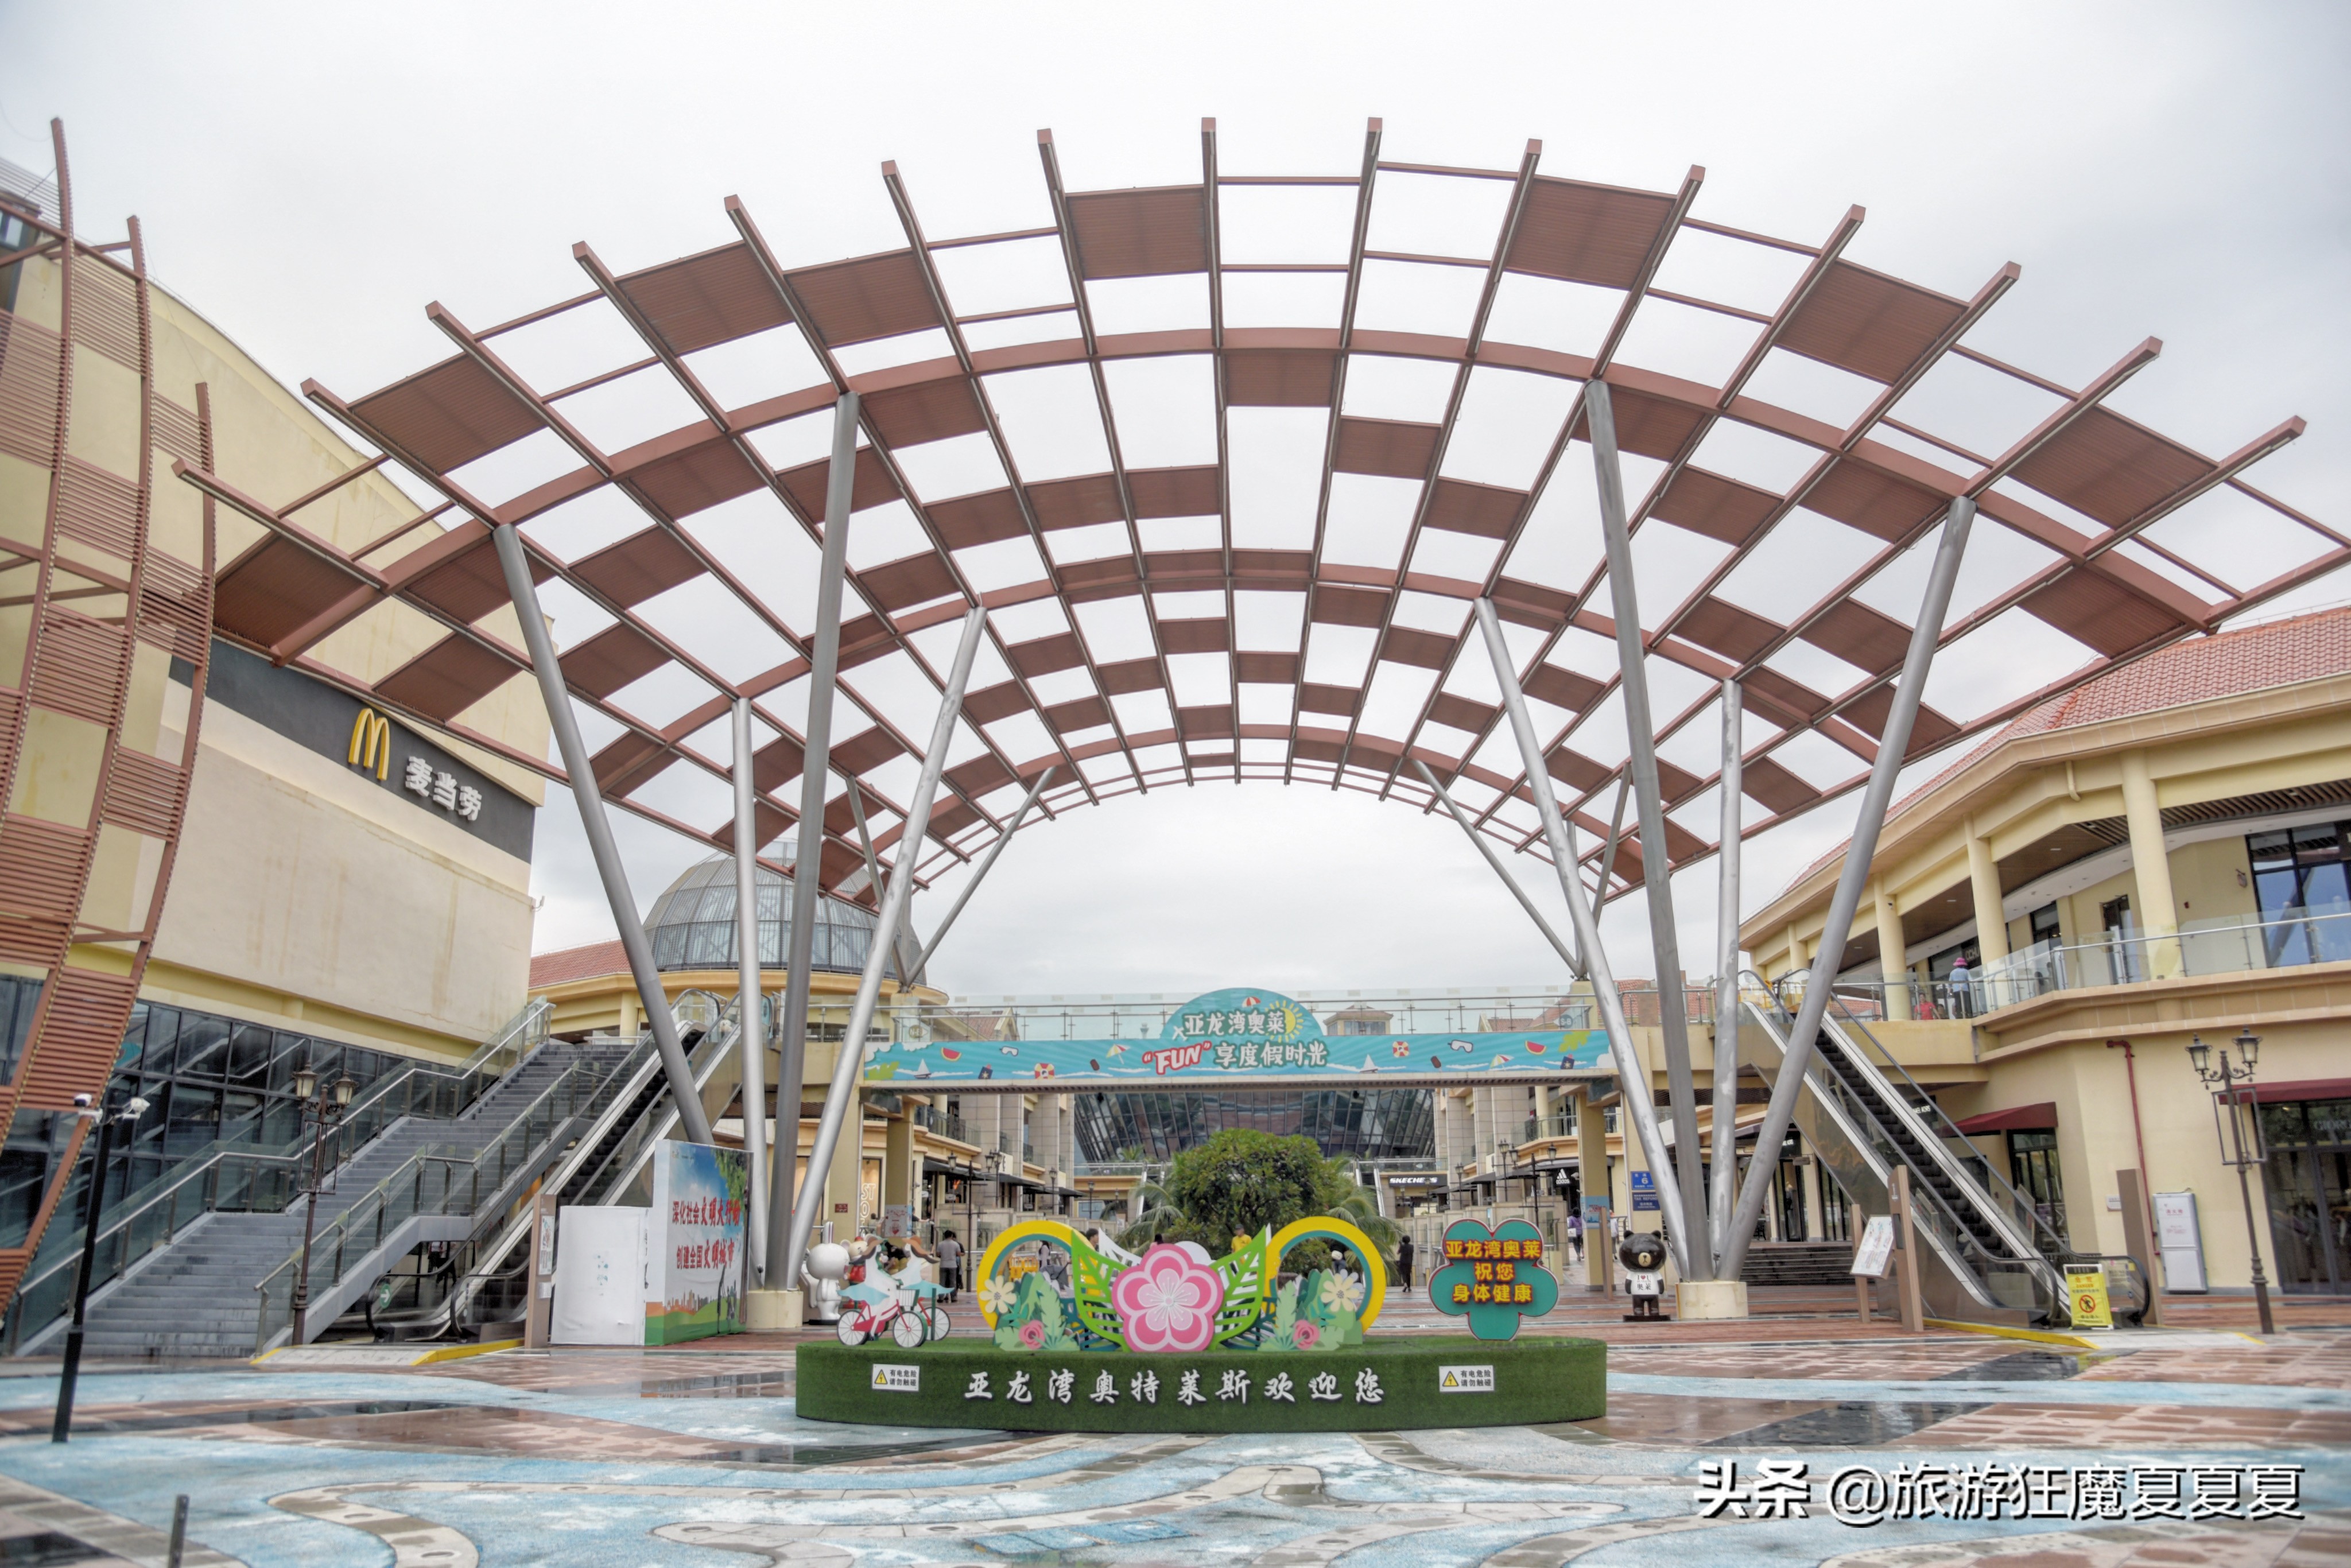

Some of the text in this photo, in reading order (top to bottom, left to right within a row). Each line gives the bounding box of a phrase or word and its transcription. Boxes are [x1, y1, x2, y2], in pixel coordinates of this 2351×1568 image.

[405, 756, 482, 821] 麦当劳
[1184, 1010, 1285, 1035] 亚龙湾奥莱
[1214, 1041, 1328, 1066] 享度假时光
[677, 1237, 735, 1270] 创建全国文明城市
[1445, 1240, 1542, 1258] 亚龙湾奥莱
[1474, 1262, 1515, 1281] 祝您
[1452, 1283, 1533, 1303] 身体健康
[890, 1369, 917, 1377] 有电危险
[890, 1378, 917, 1386] 请勿触碰
[1461, 1379, 1491, 1387] 请勿触碰
[964, 1368, 1384, 1406] 亚龙湾奥特莱斯欢迎您
